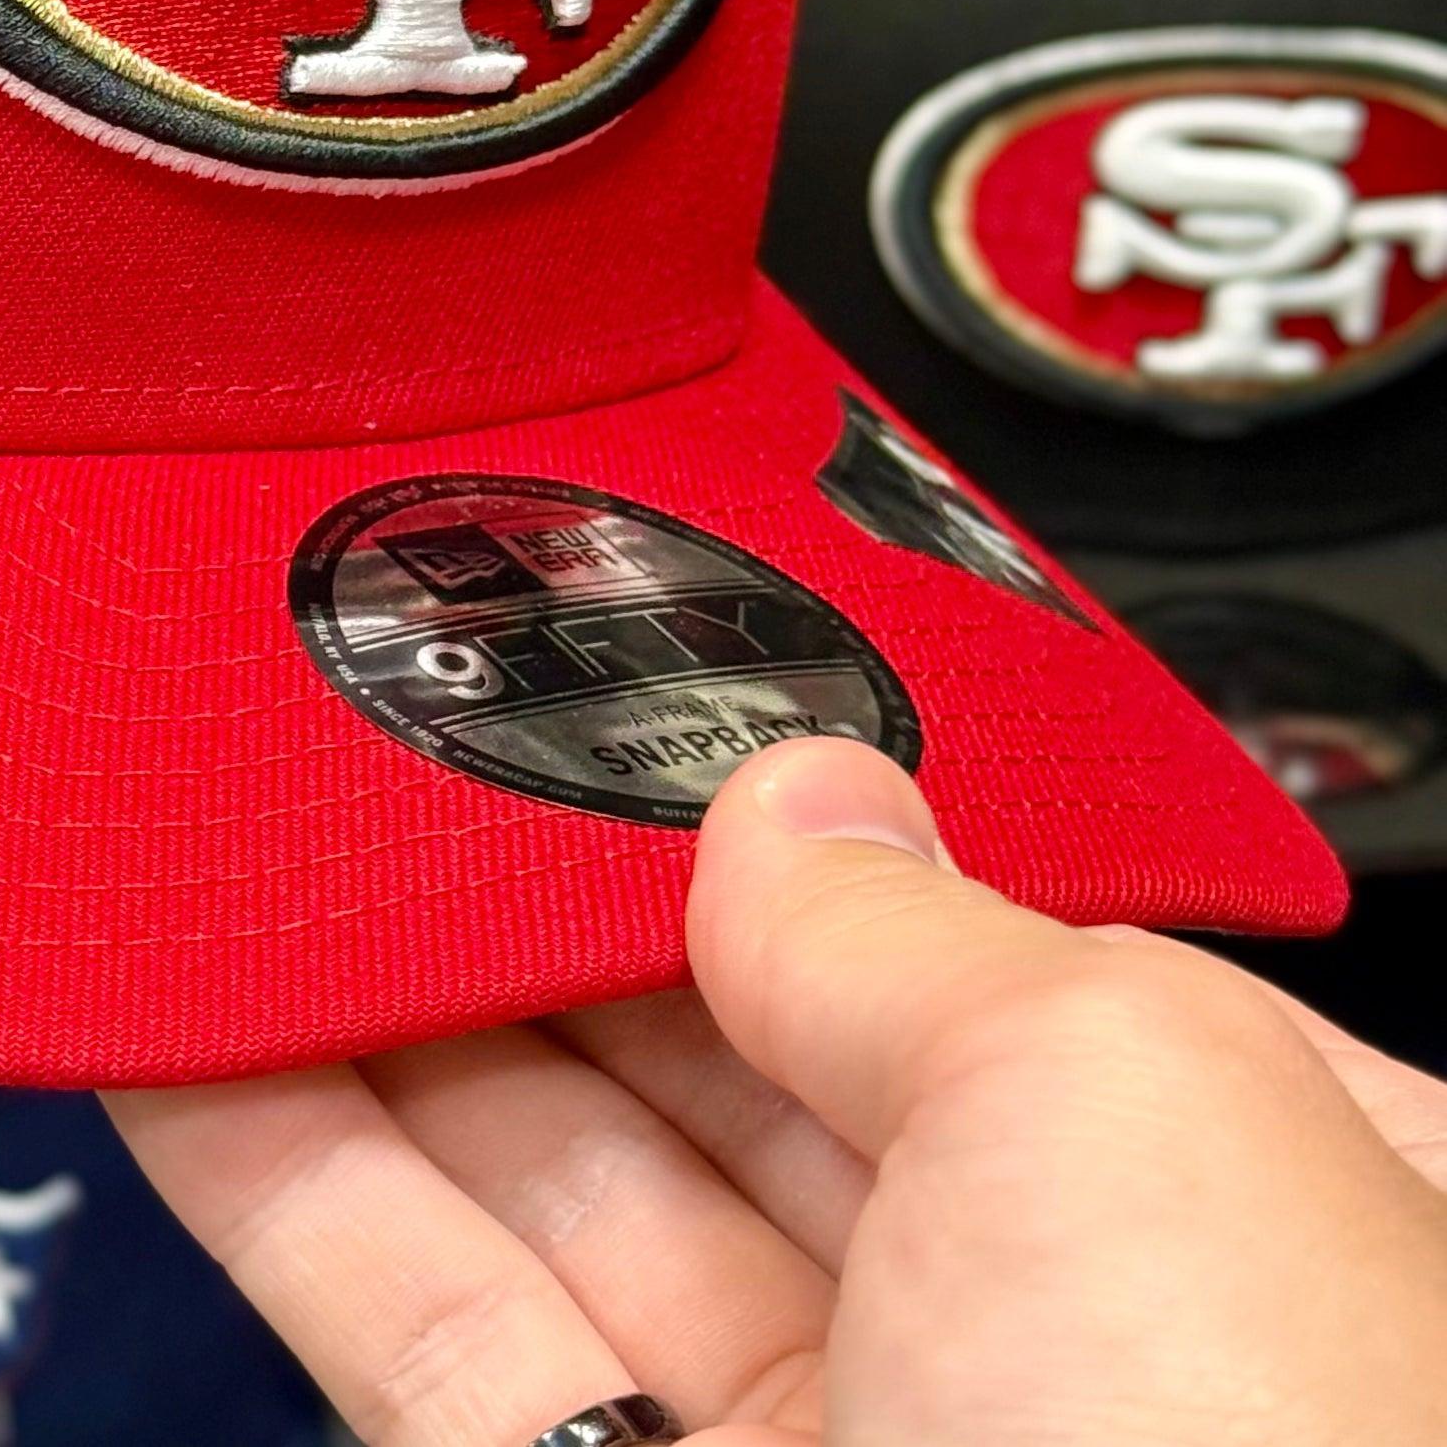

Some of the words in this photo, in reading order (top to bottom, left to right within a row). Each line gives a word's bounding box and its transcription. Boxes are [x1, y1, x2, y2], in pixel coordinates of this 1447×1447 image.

[507, 526, 594, 553] NEW
[531, 547, 619, 573] ERA
[324, 646, 343, 660] NY
[336, 664, 359, 685] USA
[372, 699, 411, 727] SINCE
[411, 725, 444, 748] 1920
[628, 695, 741, 728] A-FRAME
